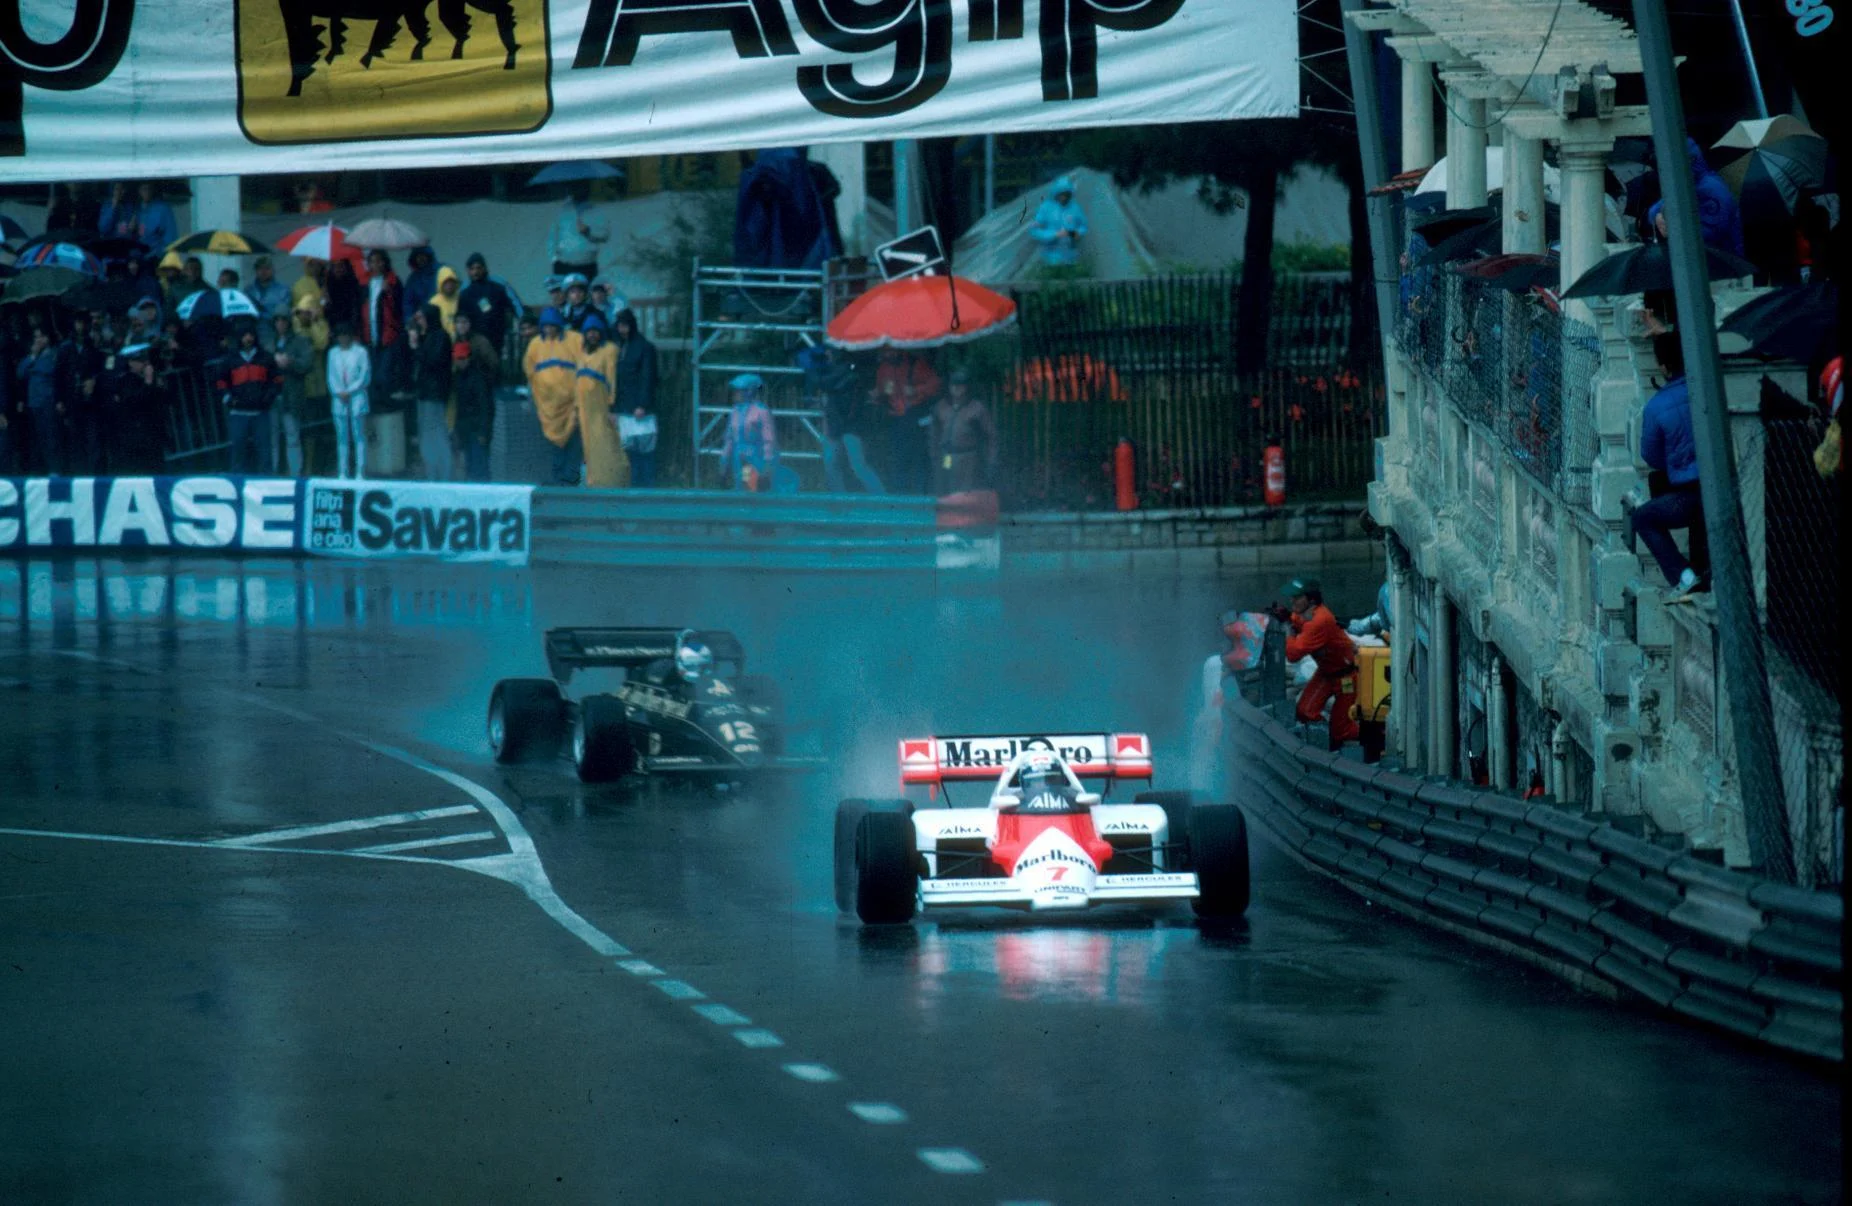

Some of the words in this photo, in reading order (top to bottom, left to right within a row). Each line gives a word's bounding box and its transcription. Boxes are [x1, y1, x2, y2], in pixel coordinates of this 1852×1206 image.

[358, 489, 525, 553] Savara
[719, 720, 758, 742] 12
[945, 739, 1092, 767] Marlro
[1016, 849, 1097, 874] Marlboro
[1046, 866, 1069, 881] 7
